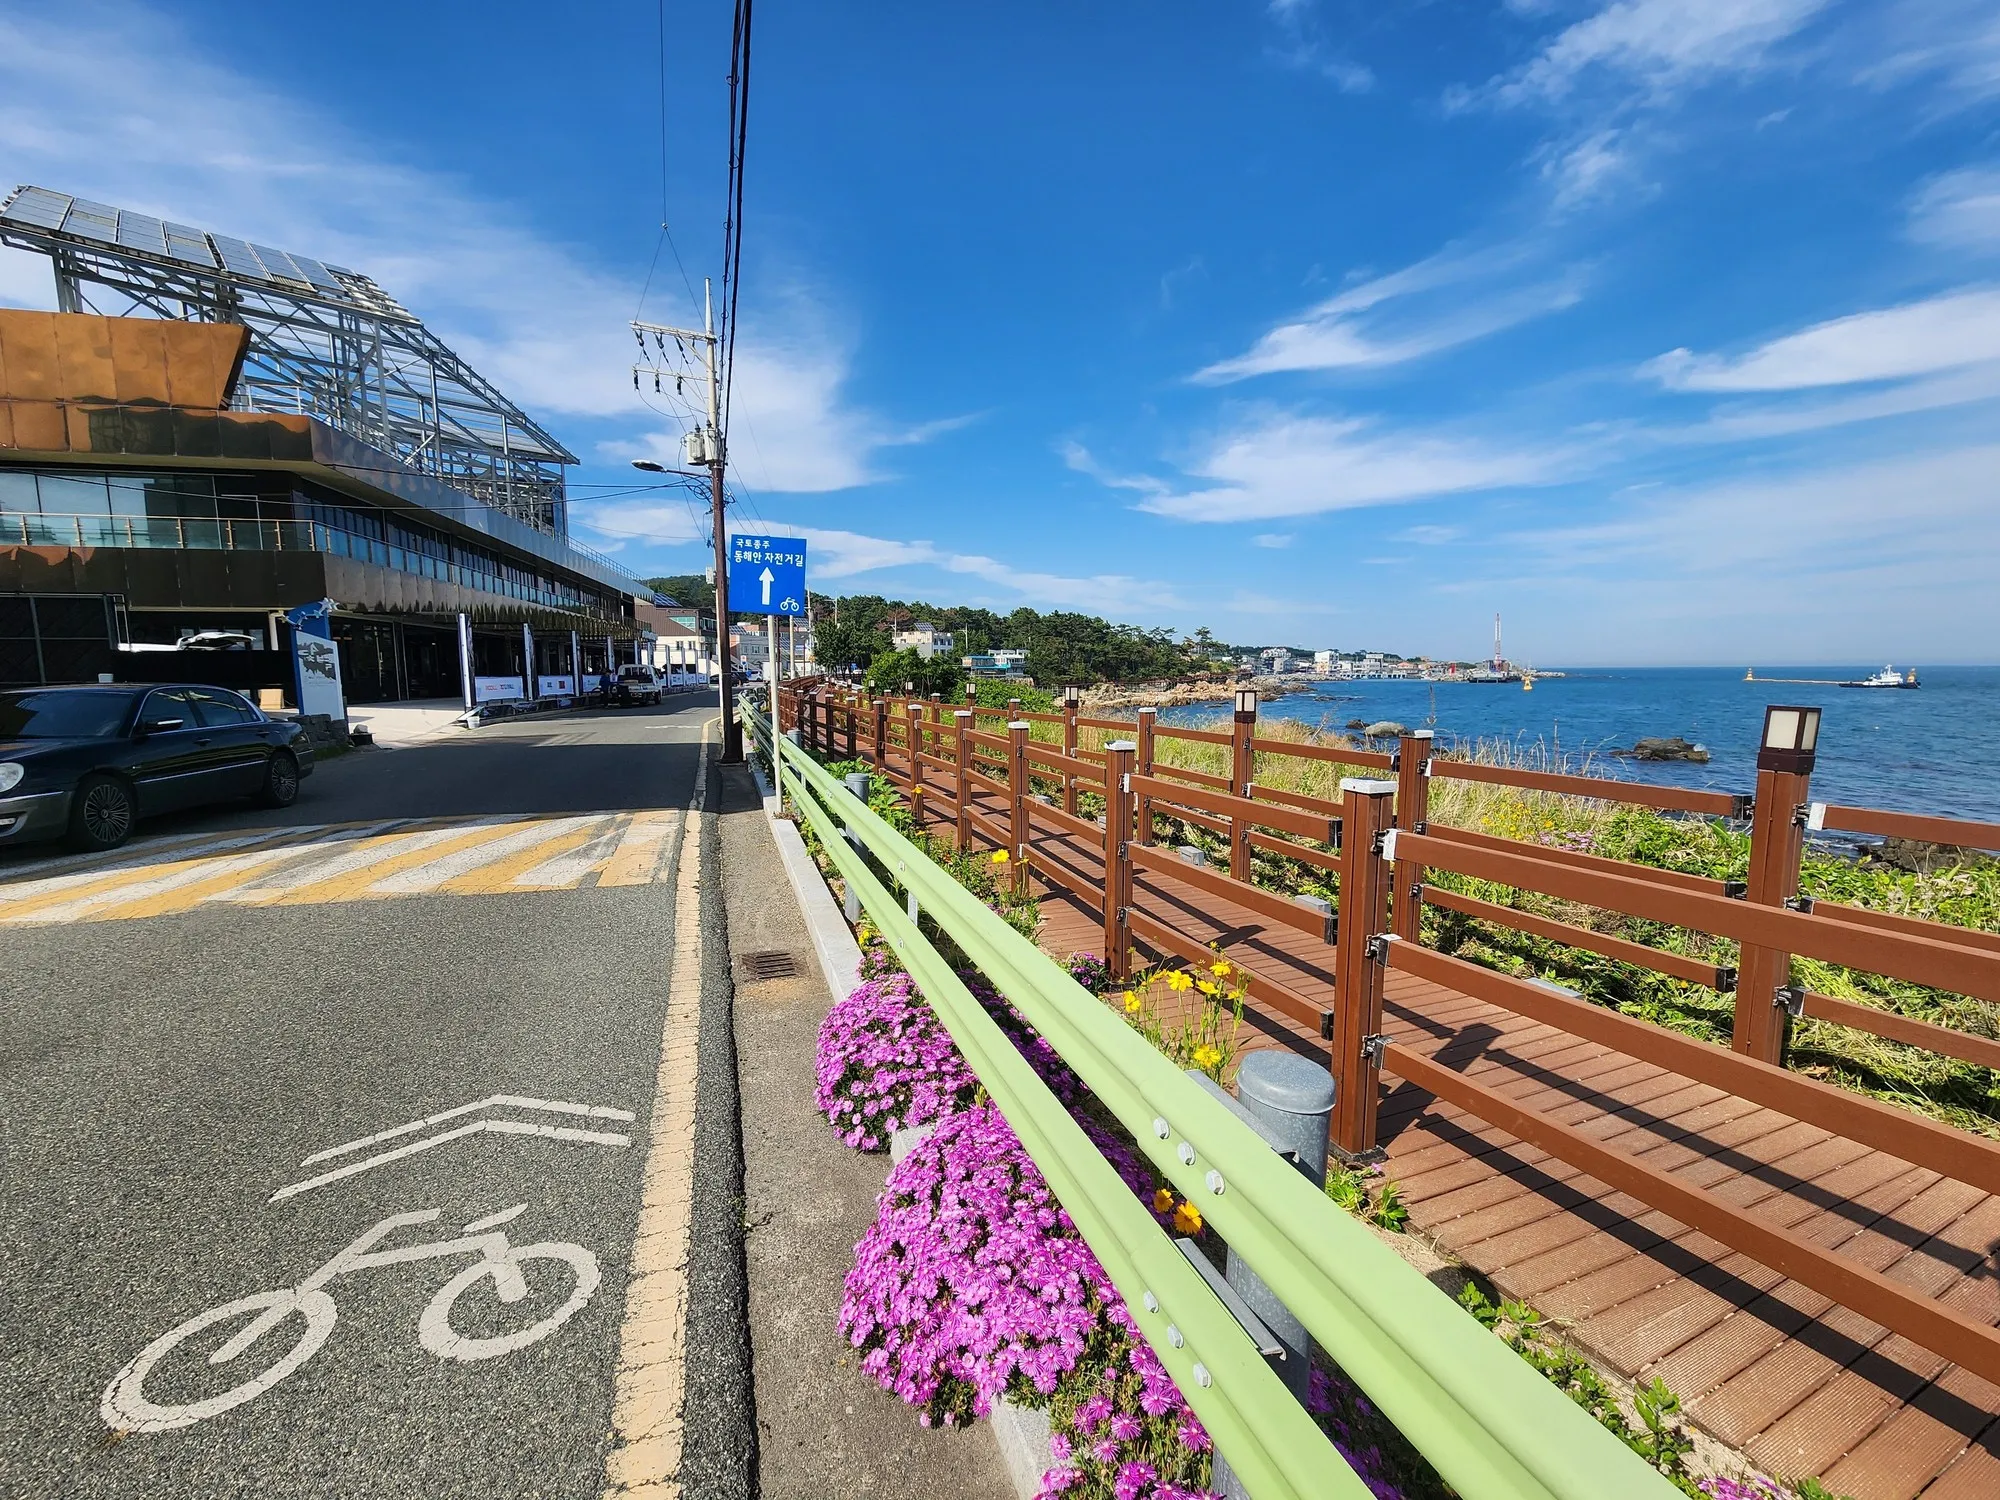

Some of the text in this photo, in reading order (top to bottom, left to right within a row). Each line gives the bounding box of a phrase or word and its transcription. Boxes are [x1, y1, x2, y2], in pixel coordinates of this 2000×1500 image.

[736, 538, 770, 549] 국토종주
[734, 550, 804, 567] 동해안 자전거길
